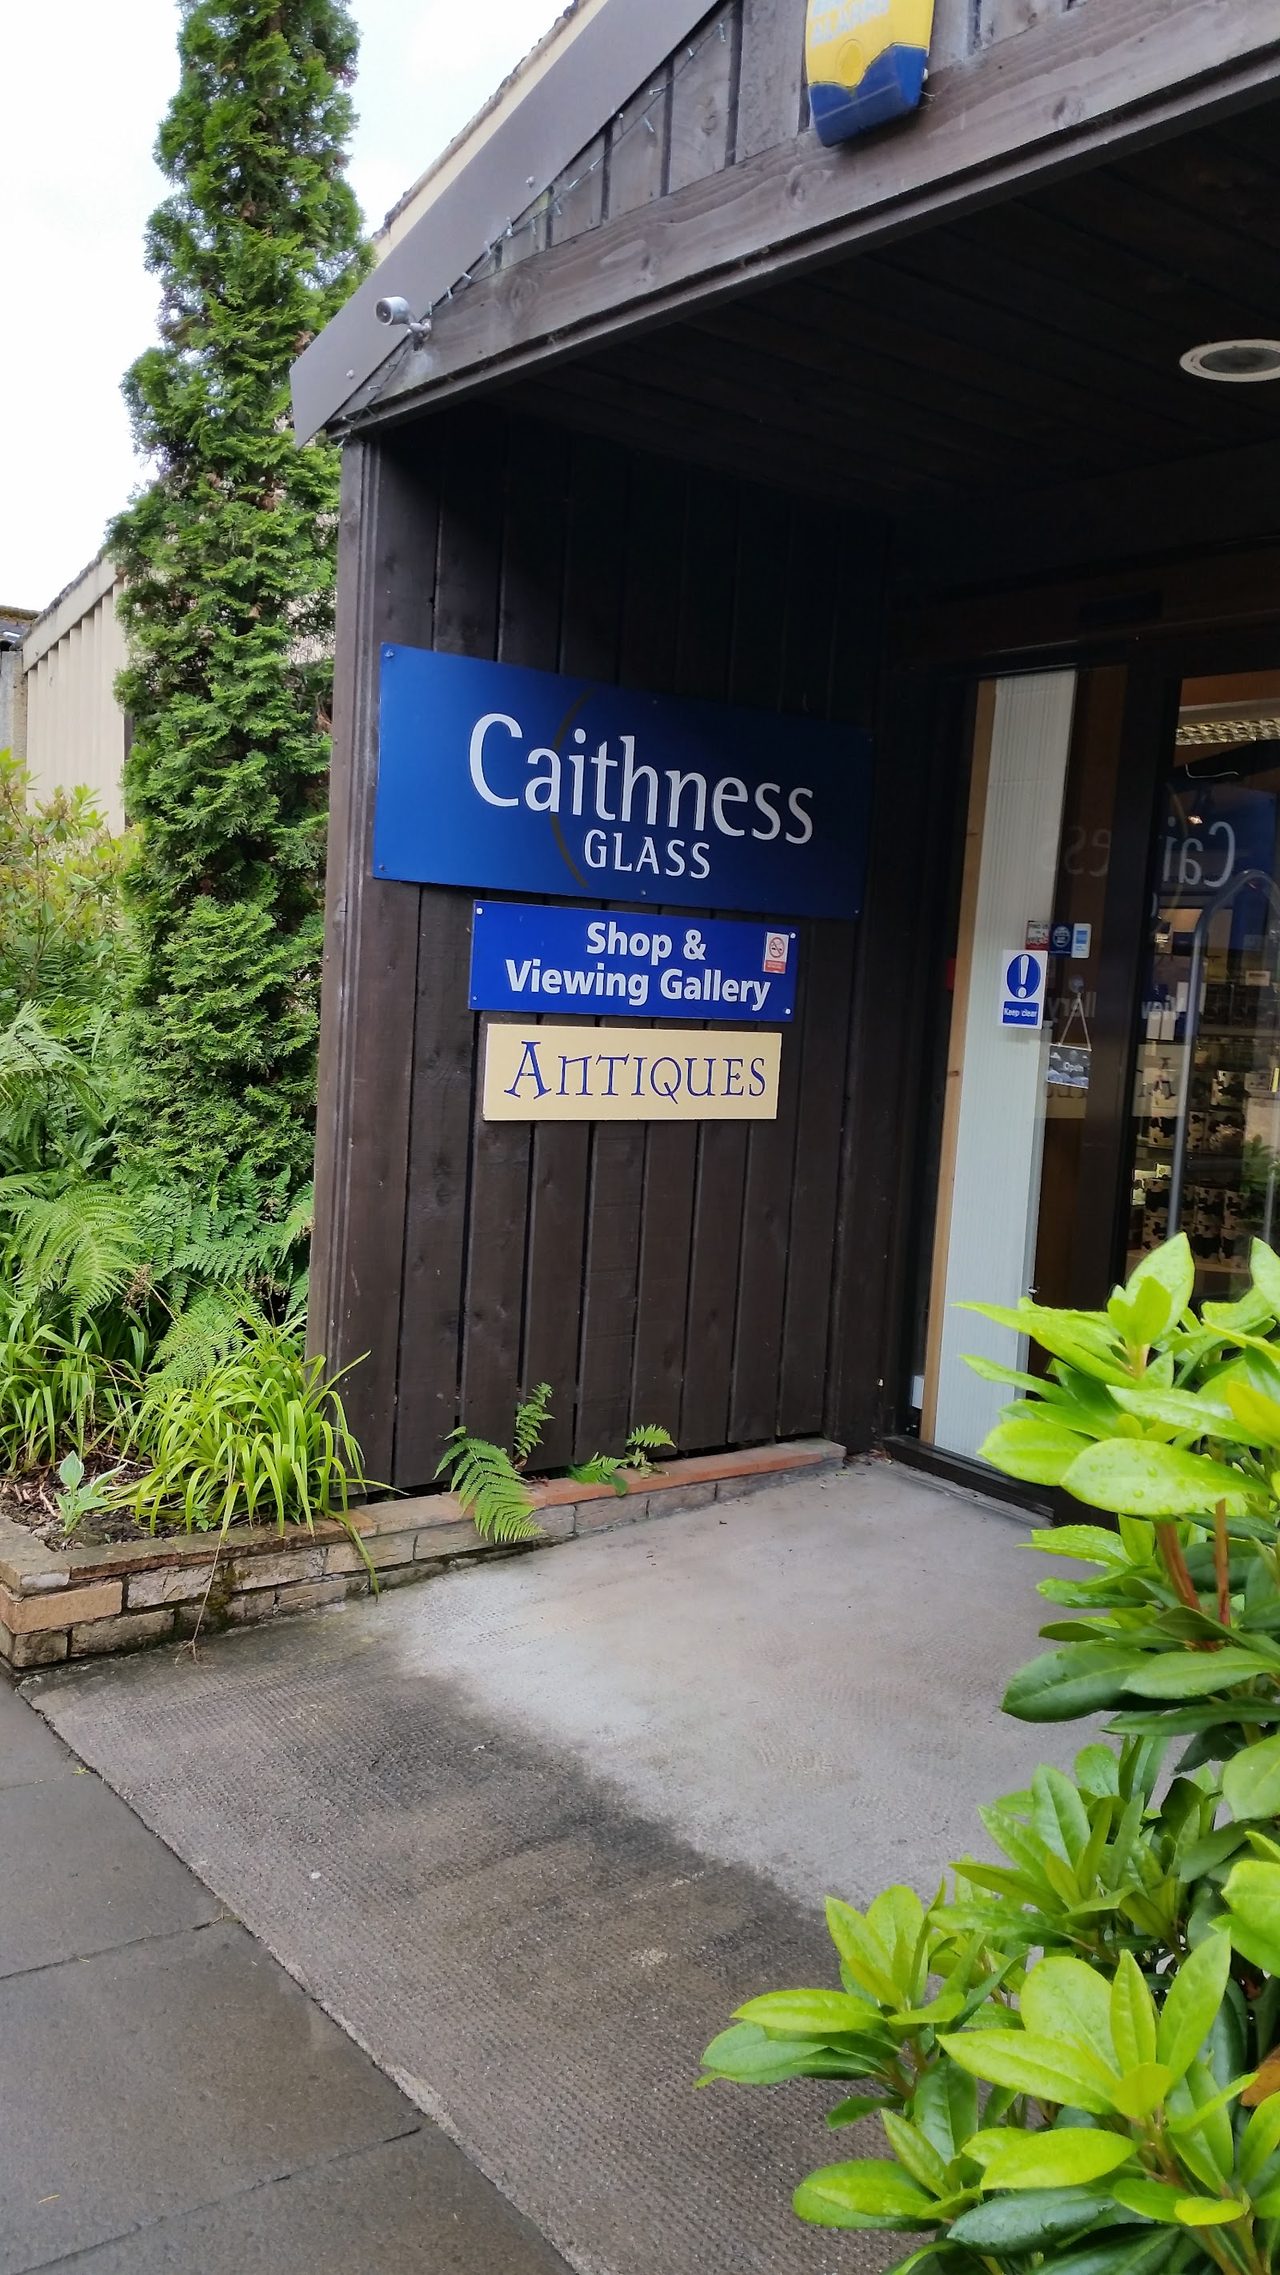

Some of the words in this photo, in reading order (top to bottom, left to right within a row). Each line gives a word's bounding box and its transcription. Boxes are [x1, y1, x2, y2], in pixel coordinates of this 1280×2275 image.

[469, 713, 814, 844] Caithness
[584, 829, 711, 879] GLASS
[586, 922, 673, 965] Shop
[683, 930, 706, 960] &
[505, 960, 649, 1005] Viewing
[660, 969, 771, 1011] Gallery
[1003, 1008, 1020, 1017] Keep
[1021, 1009, 1037, 1017] clear
[1063, 1061, 1084, 1073] Open
